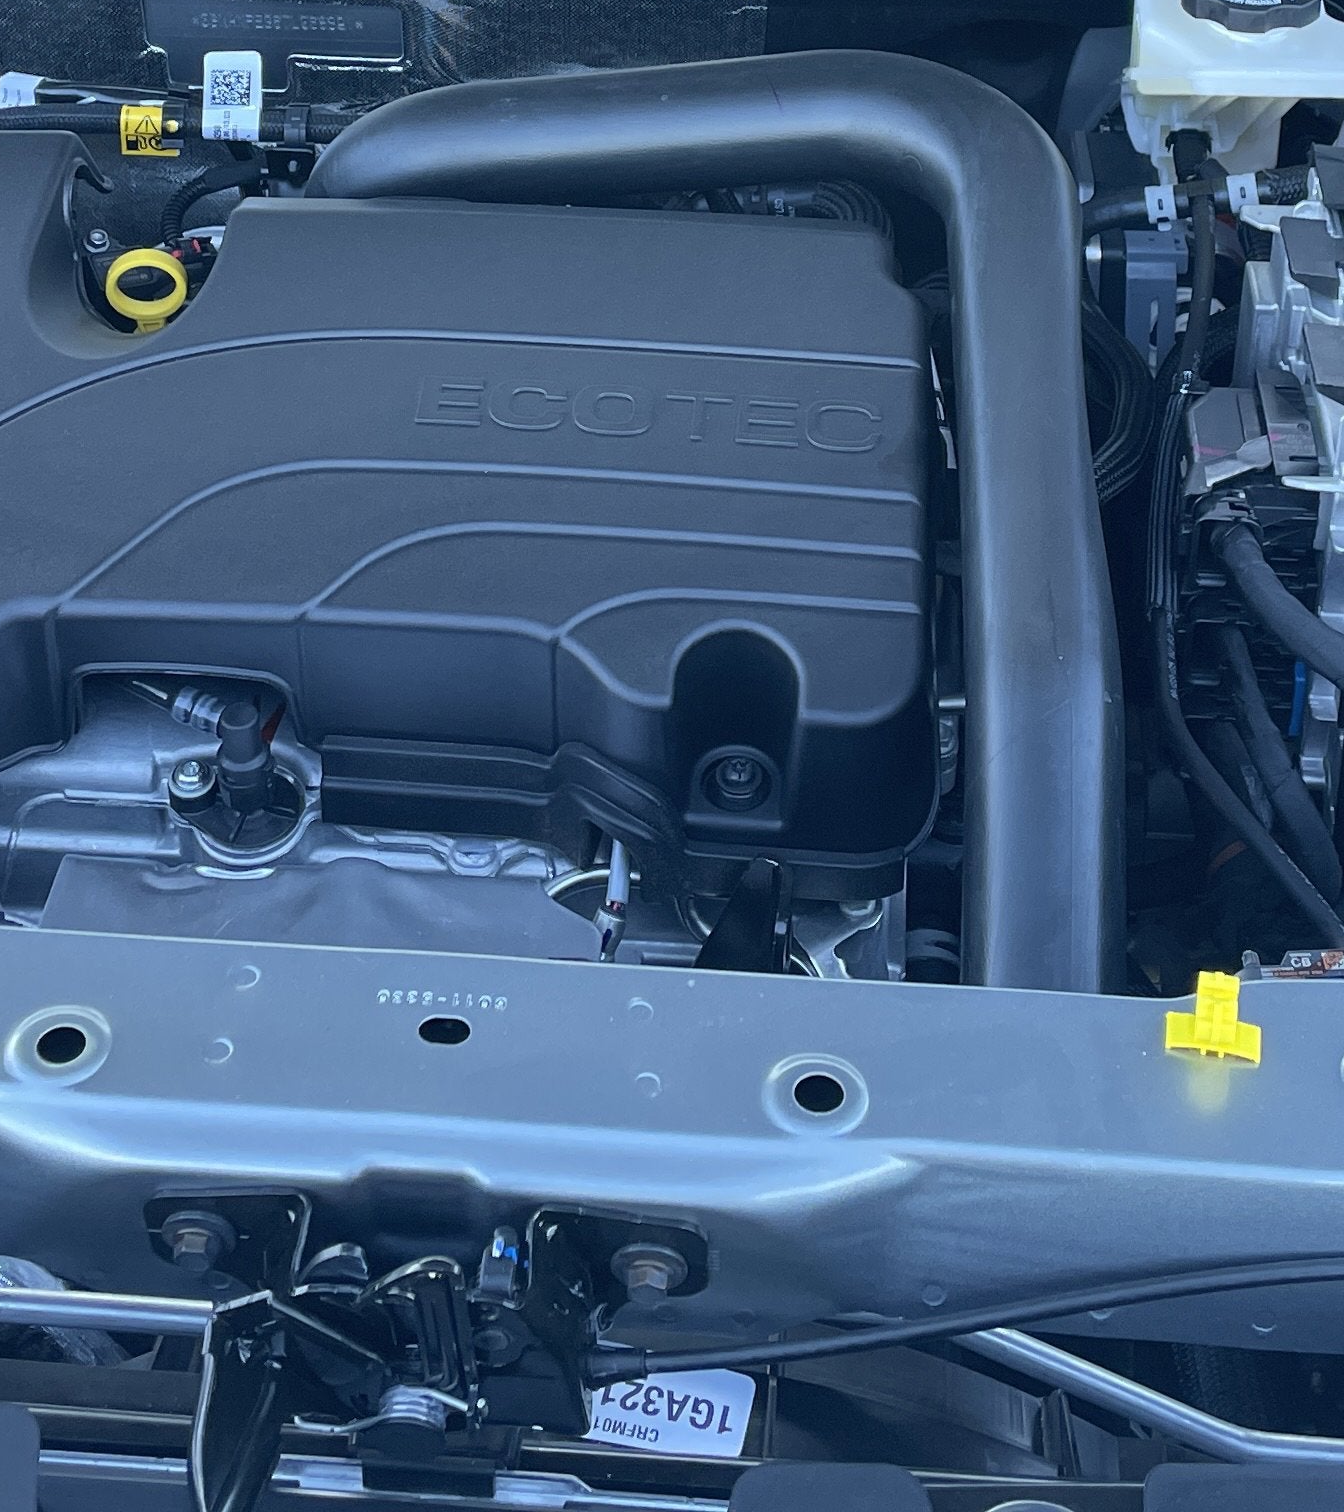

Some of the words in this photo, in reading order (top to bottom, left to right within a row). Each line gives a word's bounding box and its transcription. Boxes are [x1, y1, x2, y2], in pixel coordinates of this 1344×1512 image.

[413, 374, 884, 453] ECOTEC
[1290, 957, 1312, 968] CB
[594, 1414, 660, 1443] CRFM01
[600, 1381, 732, 1435] 1GA321
